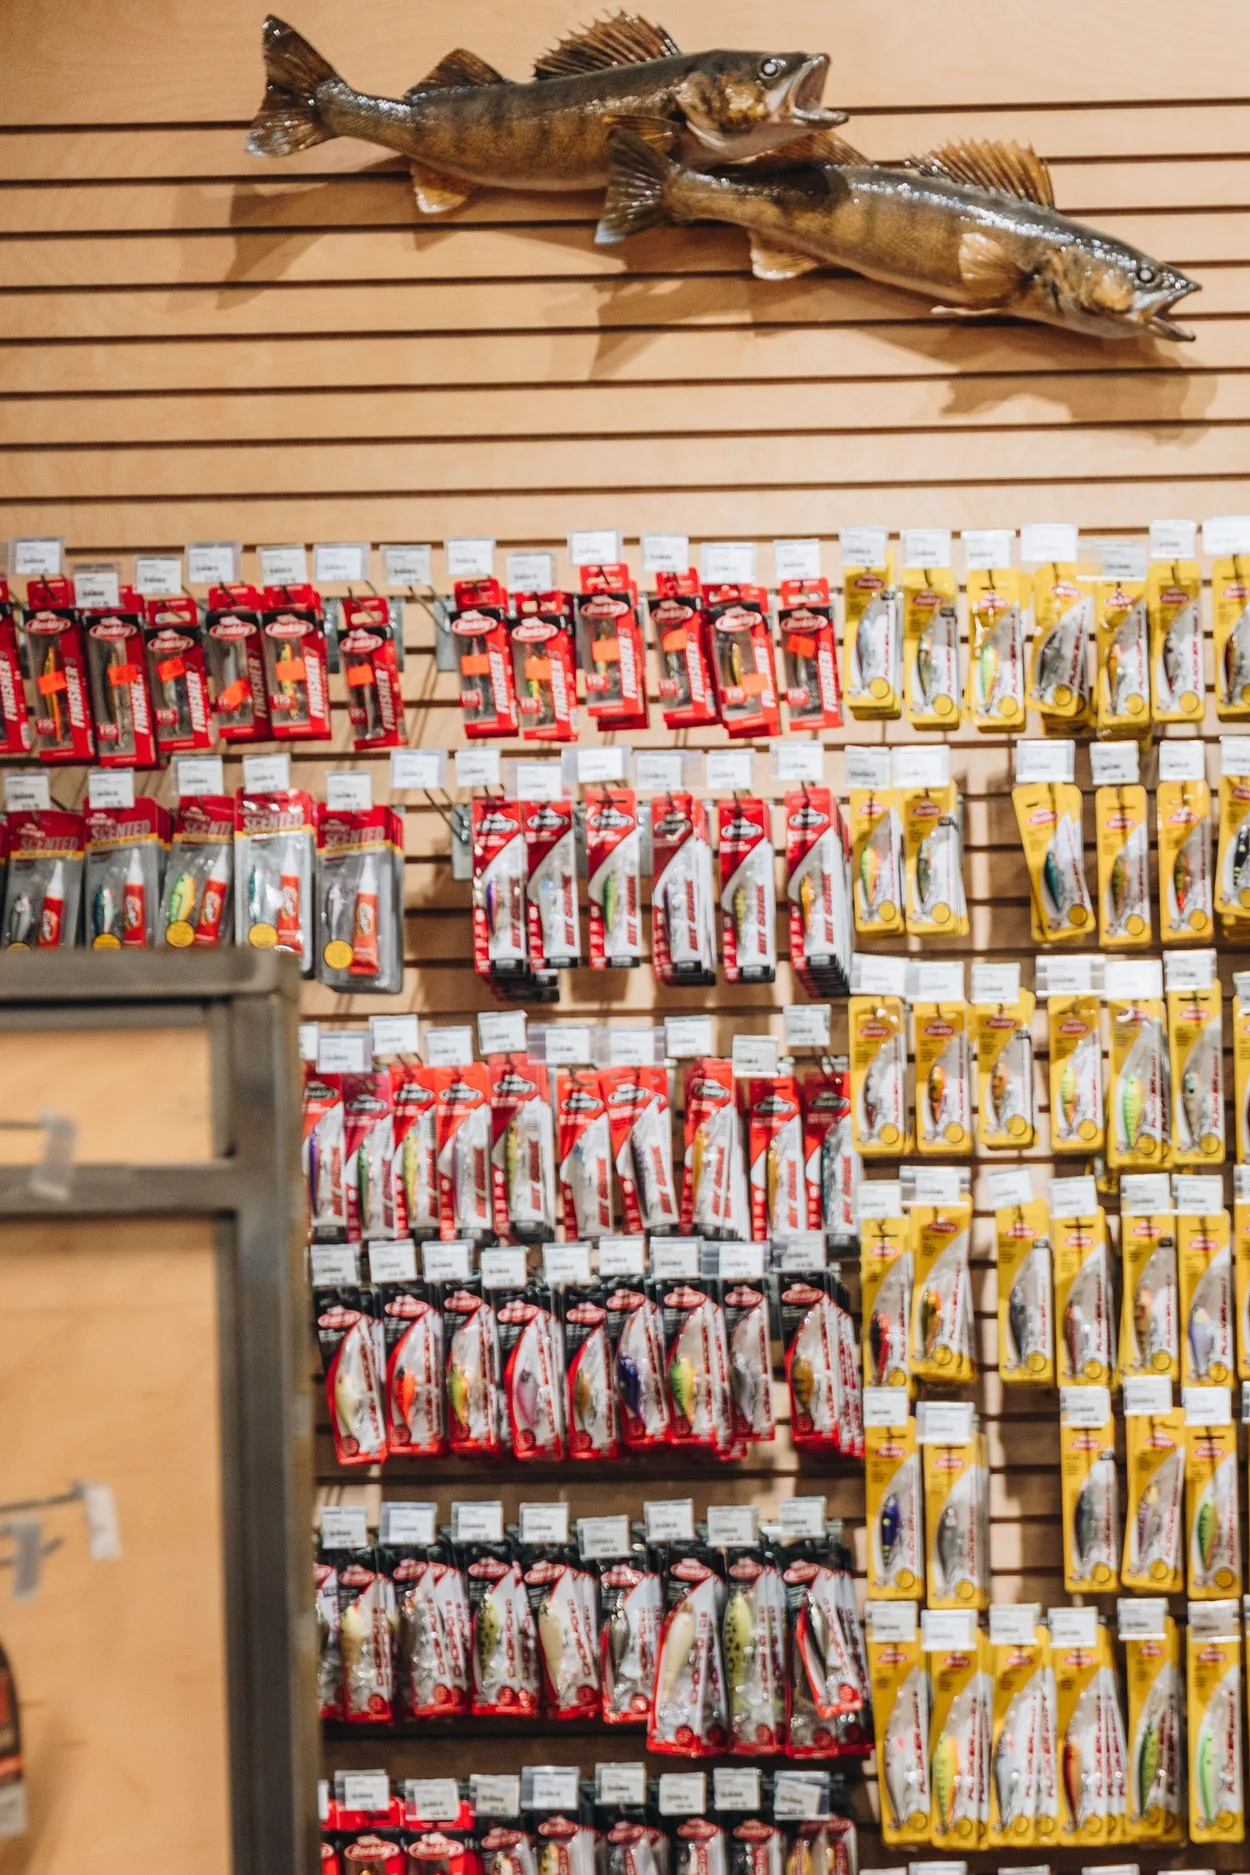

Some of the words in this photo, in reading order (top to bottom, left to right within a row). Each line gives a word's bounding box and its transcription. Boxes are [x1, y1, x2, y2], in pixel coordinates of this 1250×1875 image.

[65, 665, 85, 728] FINISHER
[248, 657, 268, 719] FINISHER
[304, 655, 324, 719] FINISHER
[489, 652, 510, 714] FINISHER
[550, 658, 568, 721] FINISHER
[618, 635, 637, 698] FINISHER
[685, 641, 705, 703] FINISHER
[818, 649, 838, 712] FINISHER
[186, 670, 207, 733] FINISHER
[376, 668, 396, 732] FINISHER
[20, 836, 79, 851] SCENTED
[91, 819, 151, 839] SCENTED
[244, 811, 305, 829] SCENTED
[325, 826, 386, 846] SCENTED
